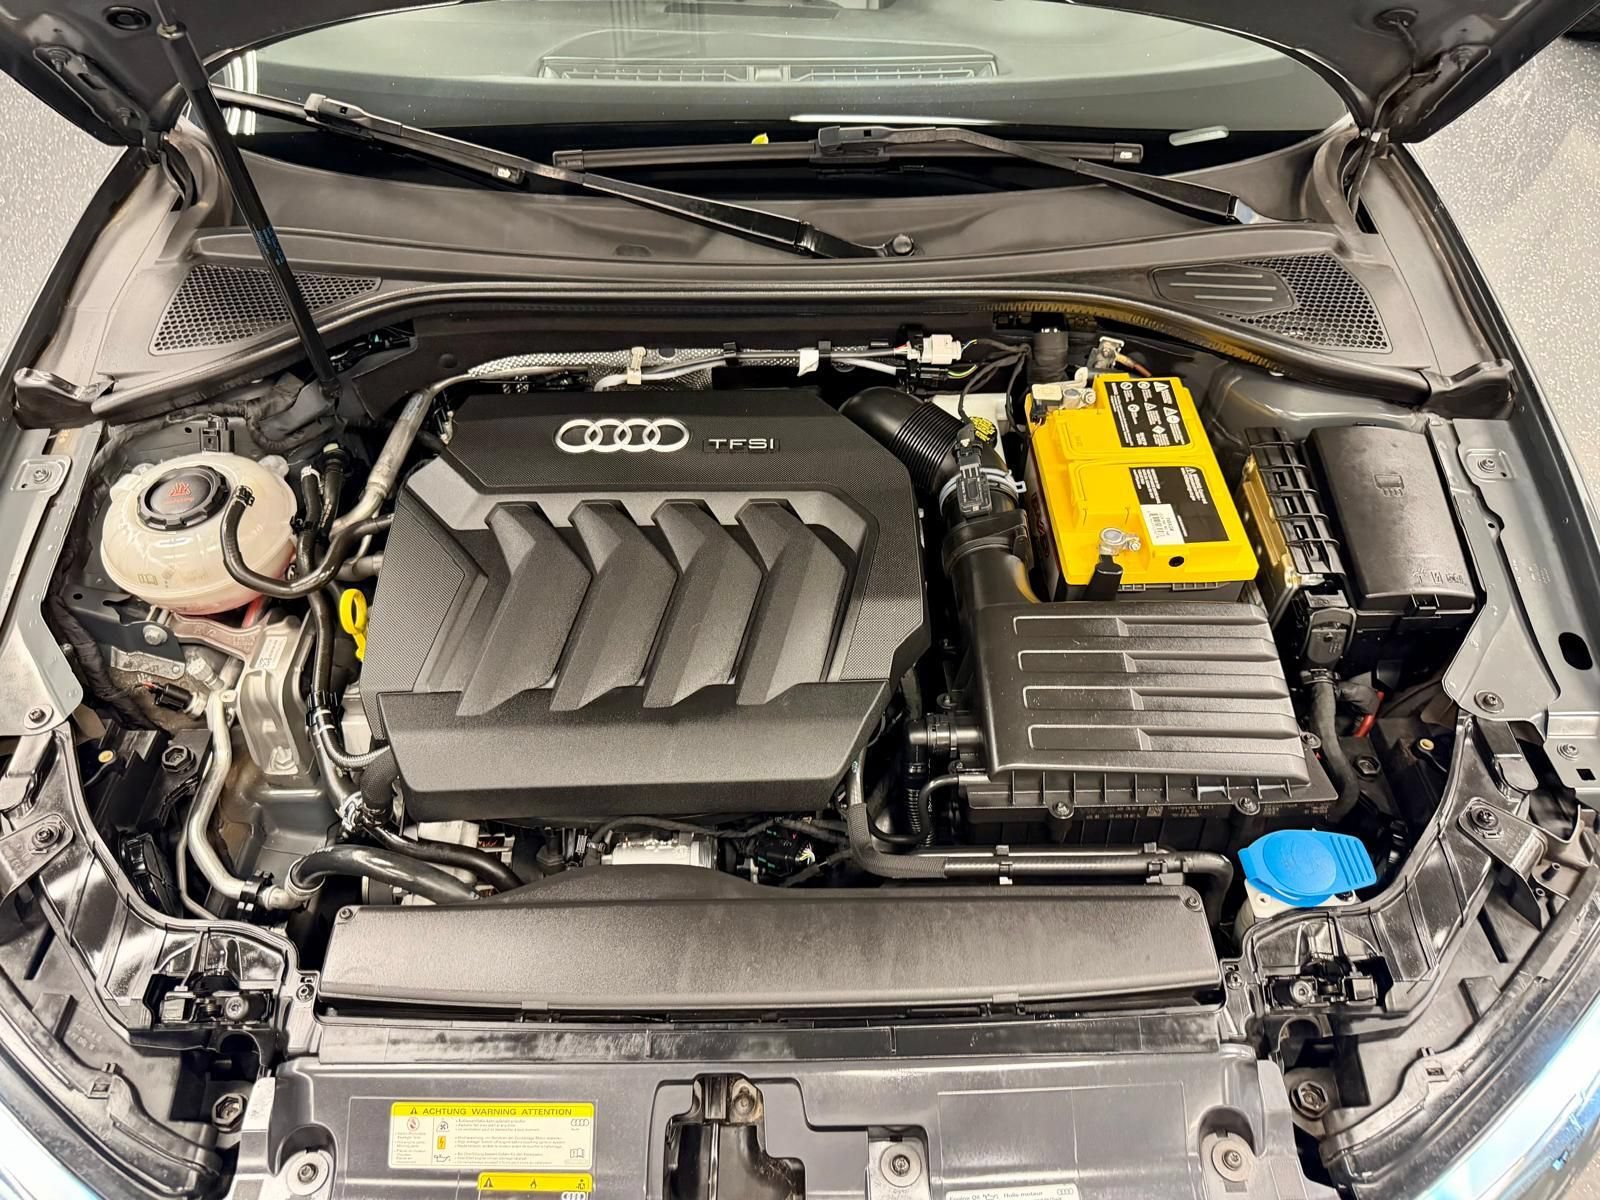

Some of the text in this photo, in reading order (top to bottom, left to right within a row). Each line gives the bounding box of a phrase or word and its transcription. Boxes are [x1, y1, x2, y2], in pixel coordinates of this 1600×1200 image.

[708, 438, 774, 449] TFSI
[423, 1108, 572, 1116] ACHTUNG WARNING ATTENTION
